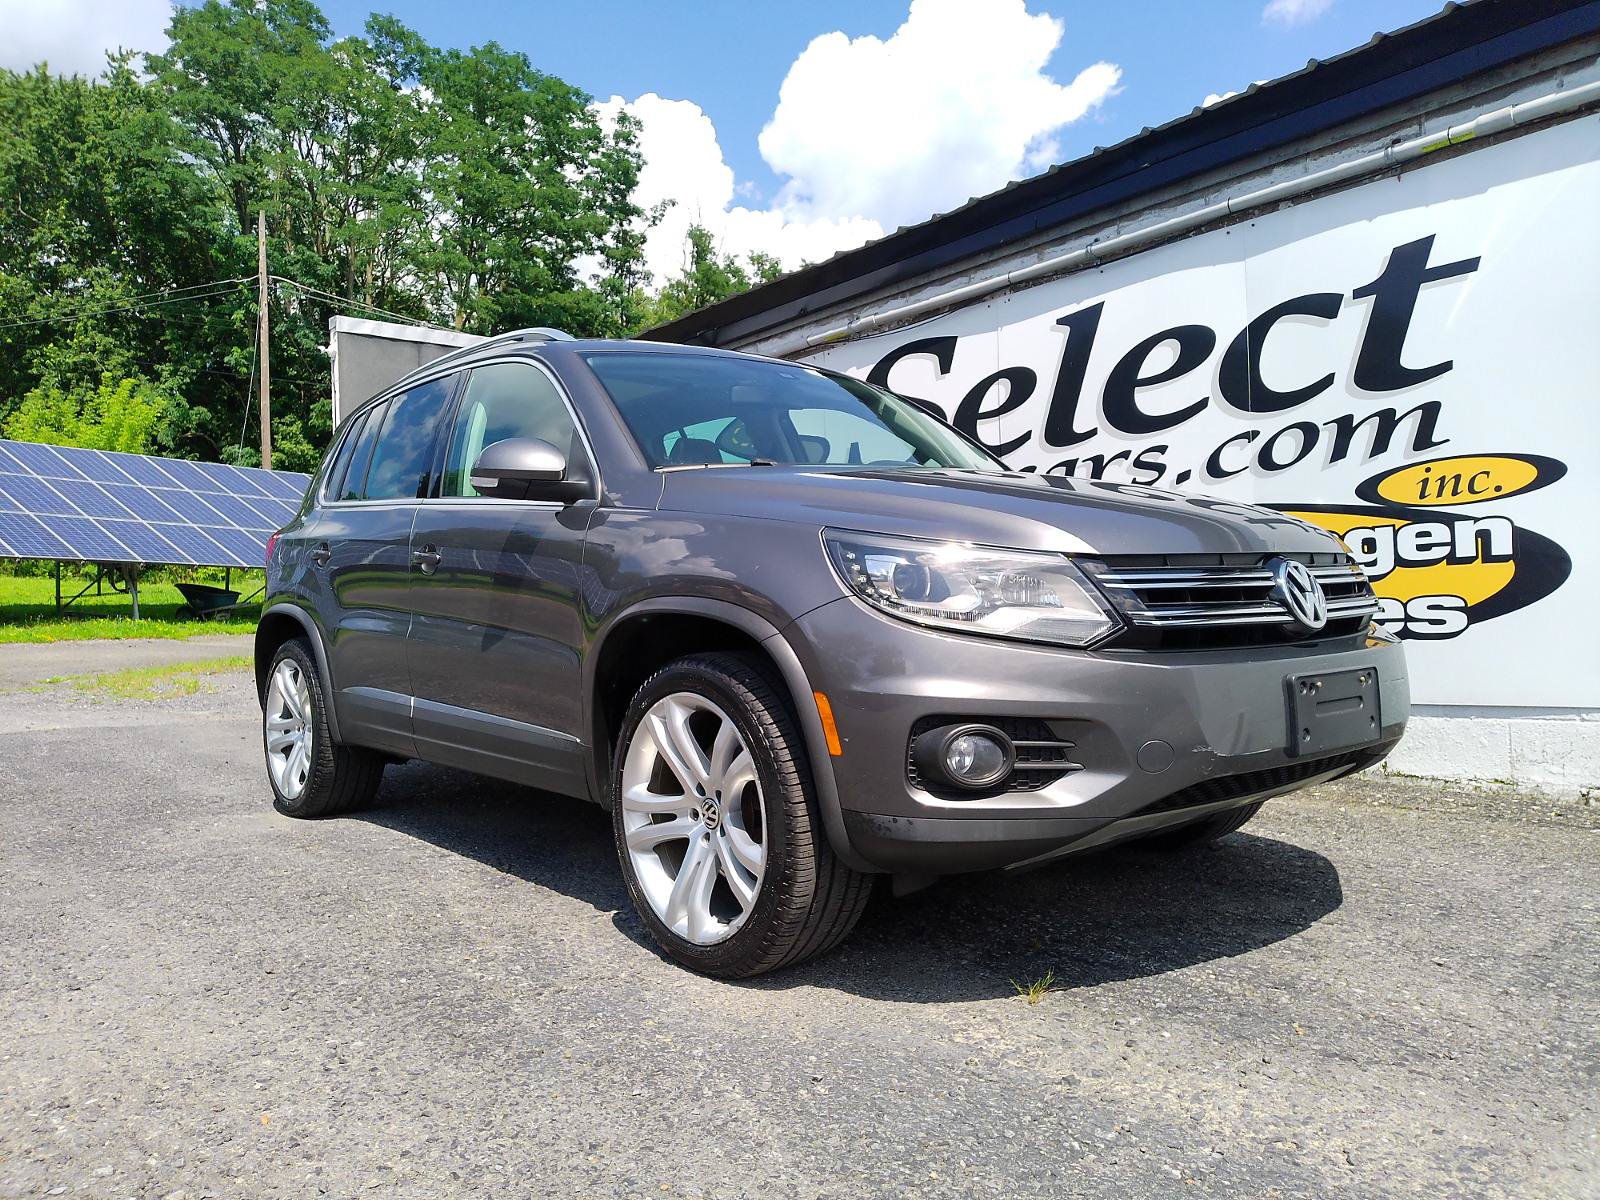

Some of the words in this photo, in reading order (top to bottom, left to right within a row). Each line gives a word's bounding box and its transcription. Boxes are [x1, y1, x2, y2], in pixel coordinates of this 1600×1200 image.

[866, 234, 1481, 456] Select
[1018, 400, 1450, 486] ars.com
[1416, 467, 1503, 500] inc.
[1331, 517, 1514, 576] gen
